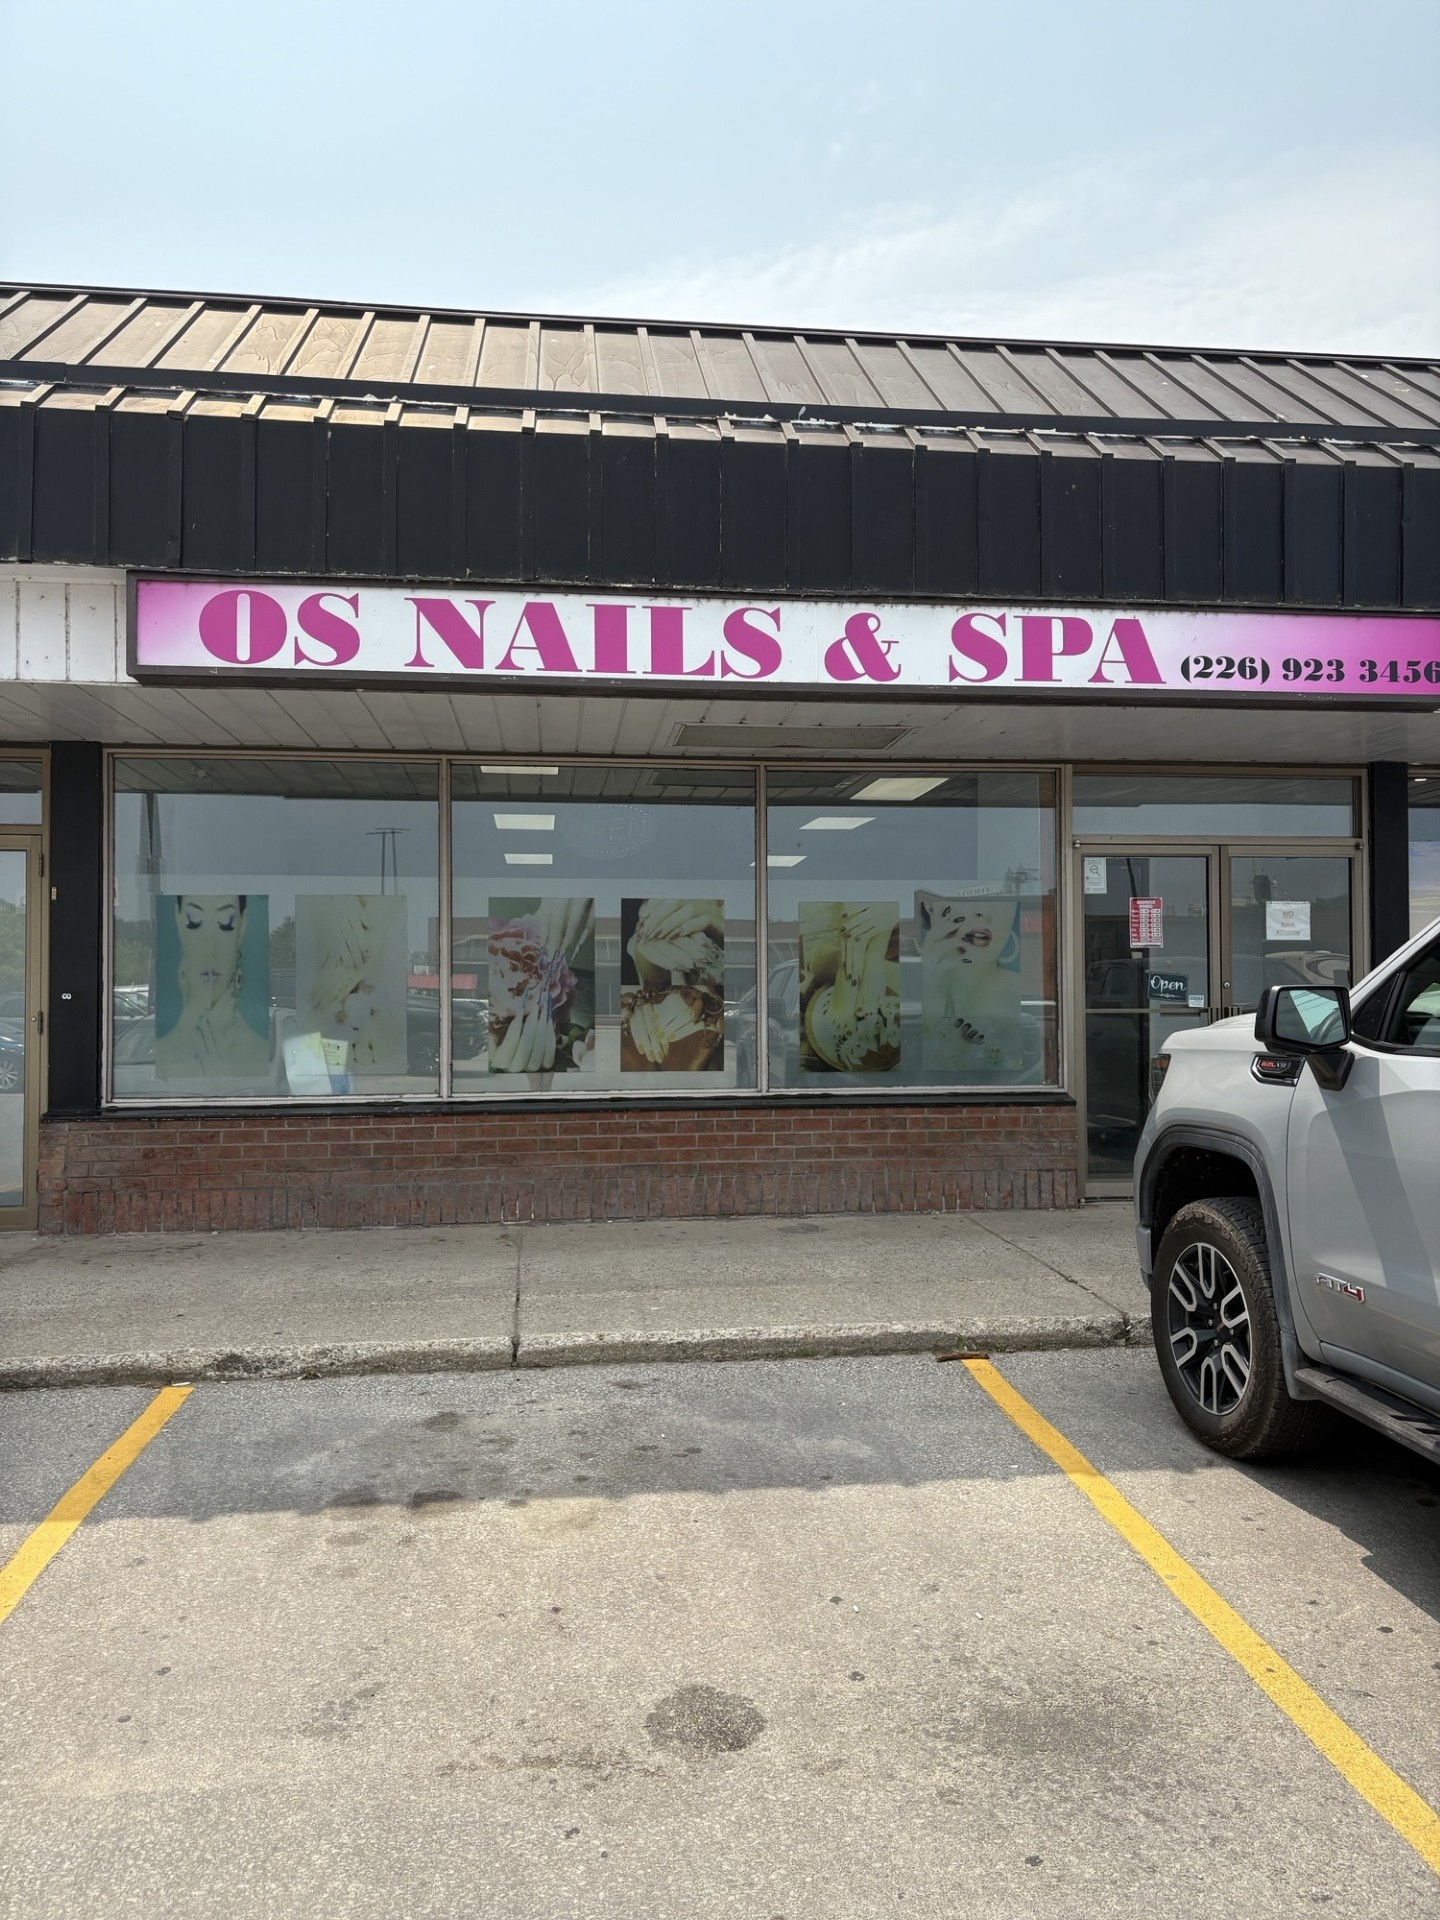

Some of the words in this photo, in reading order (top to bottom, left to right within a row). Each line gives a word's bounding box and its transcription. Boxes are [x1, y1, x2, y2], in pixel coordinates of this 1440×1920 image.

[199, 589, 360, 667] OS
[405, 597, 783, 679] NAILS
[824, 612, 901, 682] &
[948, 613, 1166, 685] SPA
[1180, 655, 1270, 685] (226)
[1282, 658, 1346, 682] 923
[1359, 659, 1440, 684] 3456
[1150, 975, 1187, 993] Open
[1314, 1272, 1365, 1304] AT4
